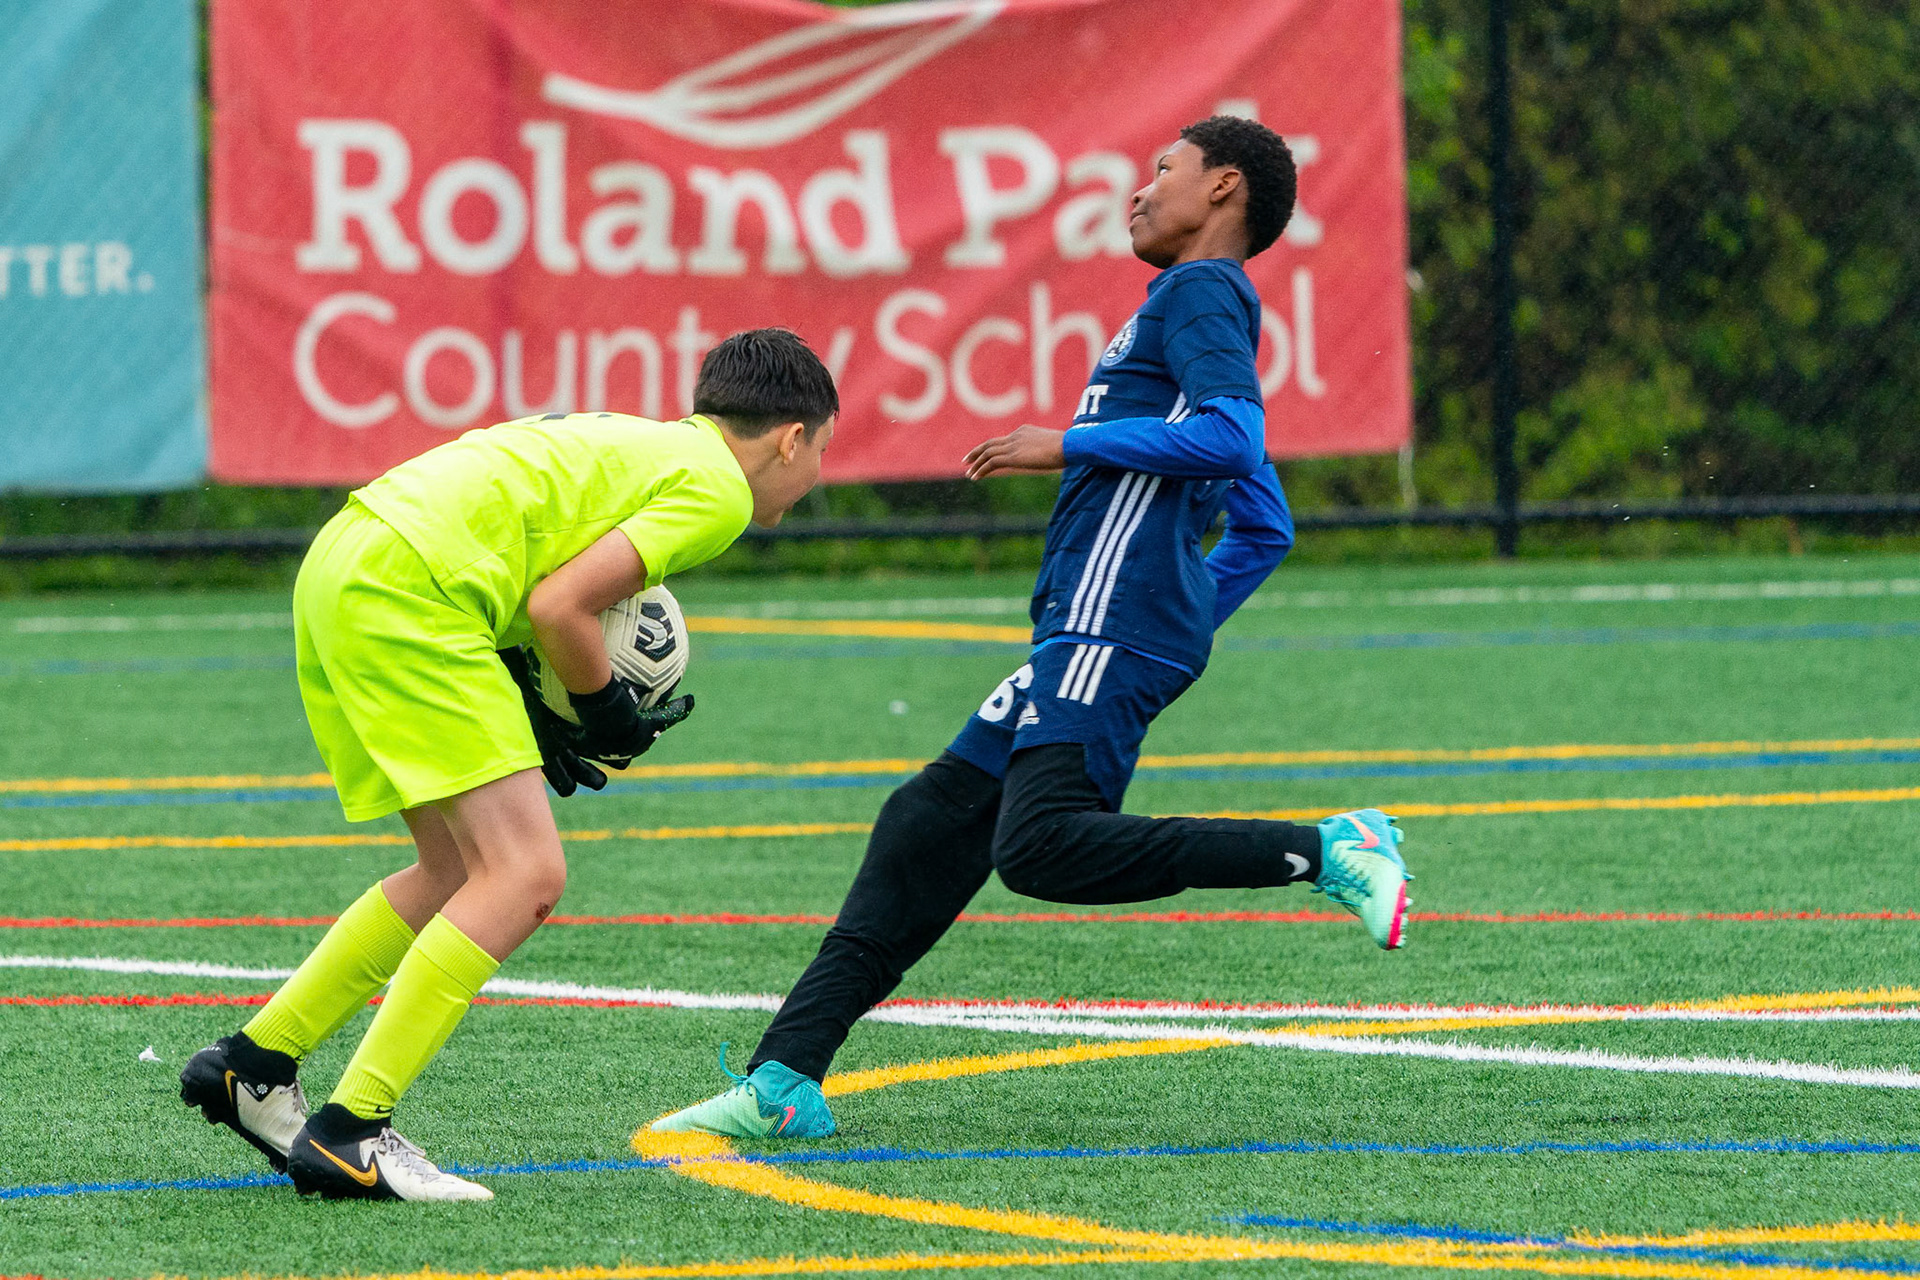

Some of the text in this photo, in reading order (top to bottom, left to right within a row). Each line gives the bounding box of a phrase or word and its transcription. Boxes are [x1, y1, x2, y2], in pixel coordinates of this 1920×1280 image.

[295, 98, 1326, 276] Roland Pa
[294, 268, 1327, 429] Count Schl
